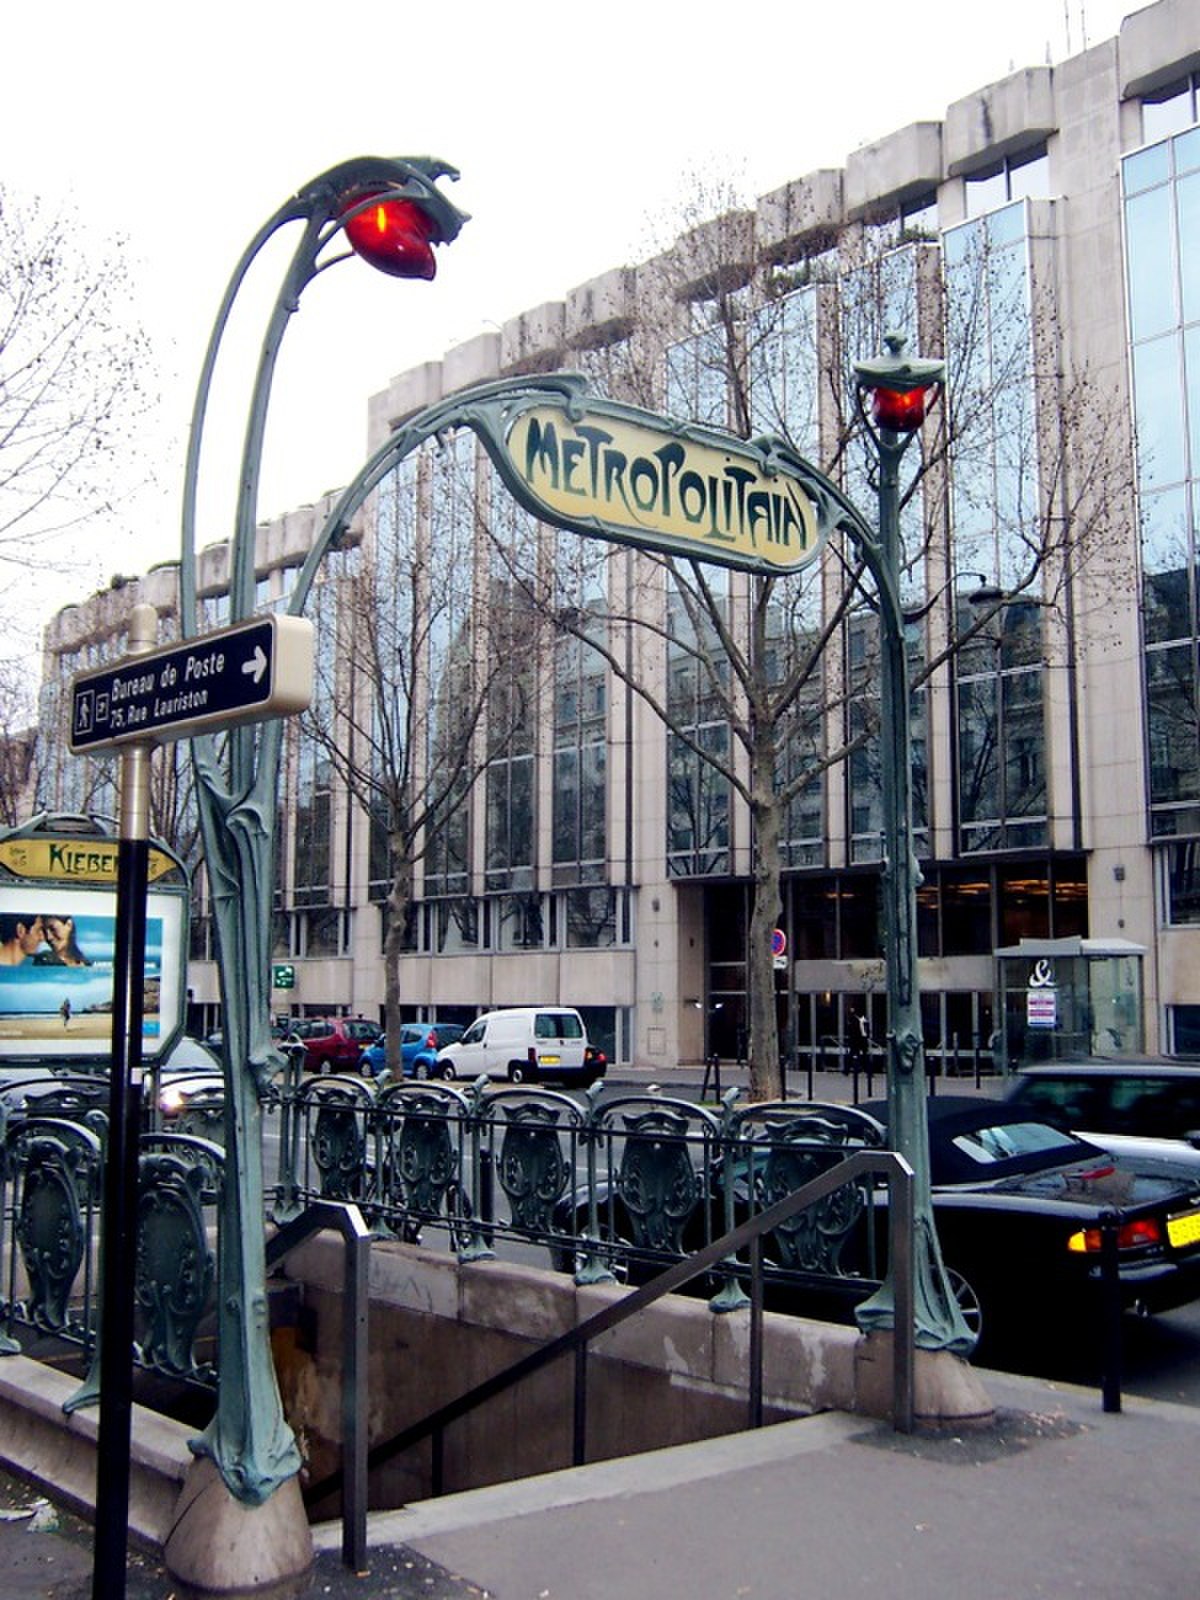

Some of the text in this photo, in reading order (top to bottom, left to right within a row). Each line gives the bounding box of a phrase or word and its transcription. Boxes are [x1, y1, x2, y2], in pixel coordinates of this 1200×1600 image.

[526, 417, 807, 550] METROPOLITAIN
[111, 653, 225, 702] Bureau de Poste
[127, 705, 148, 725] Rue
[153, 690, 208, 717] Lauriston
